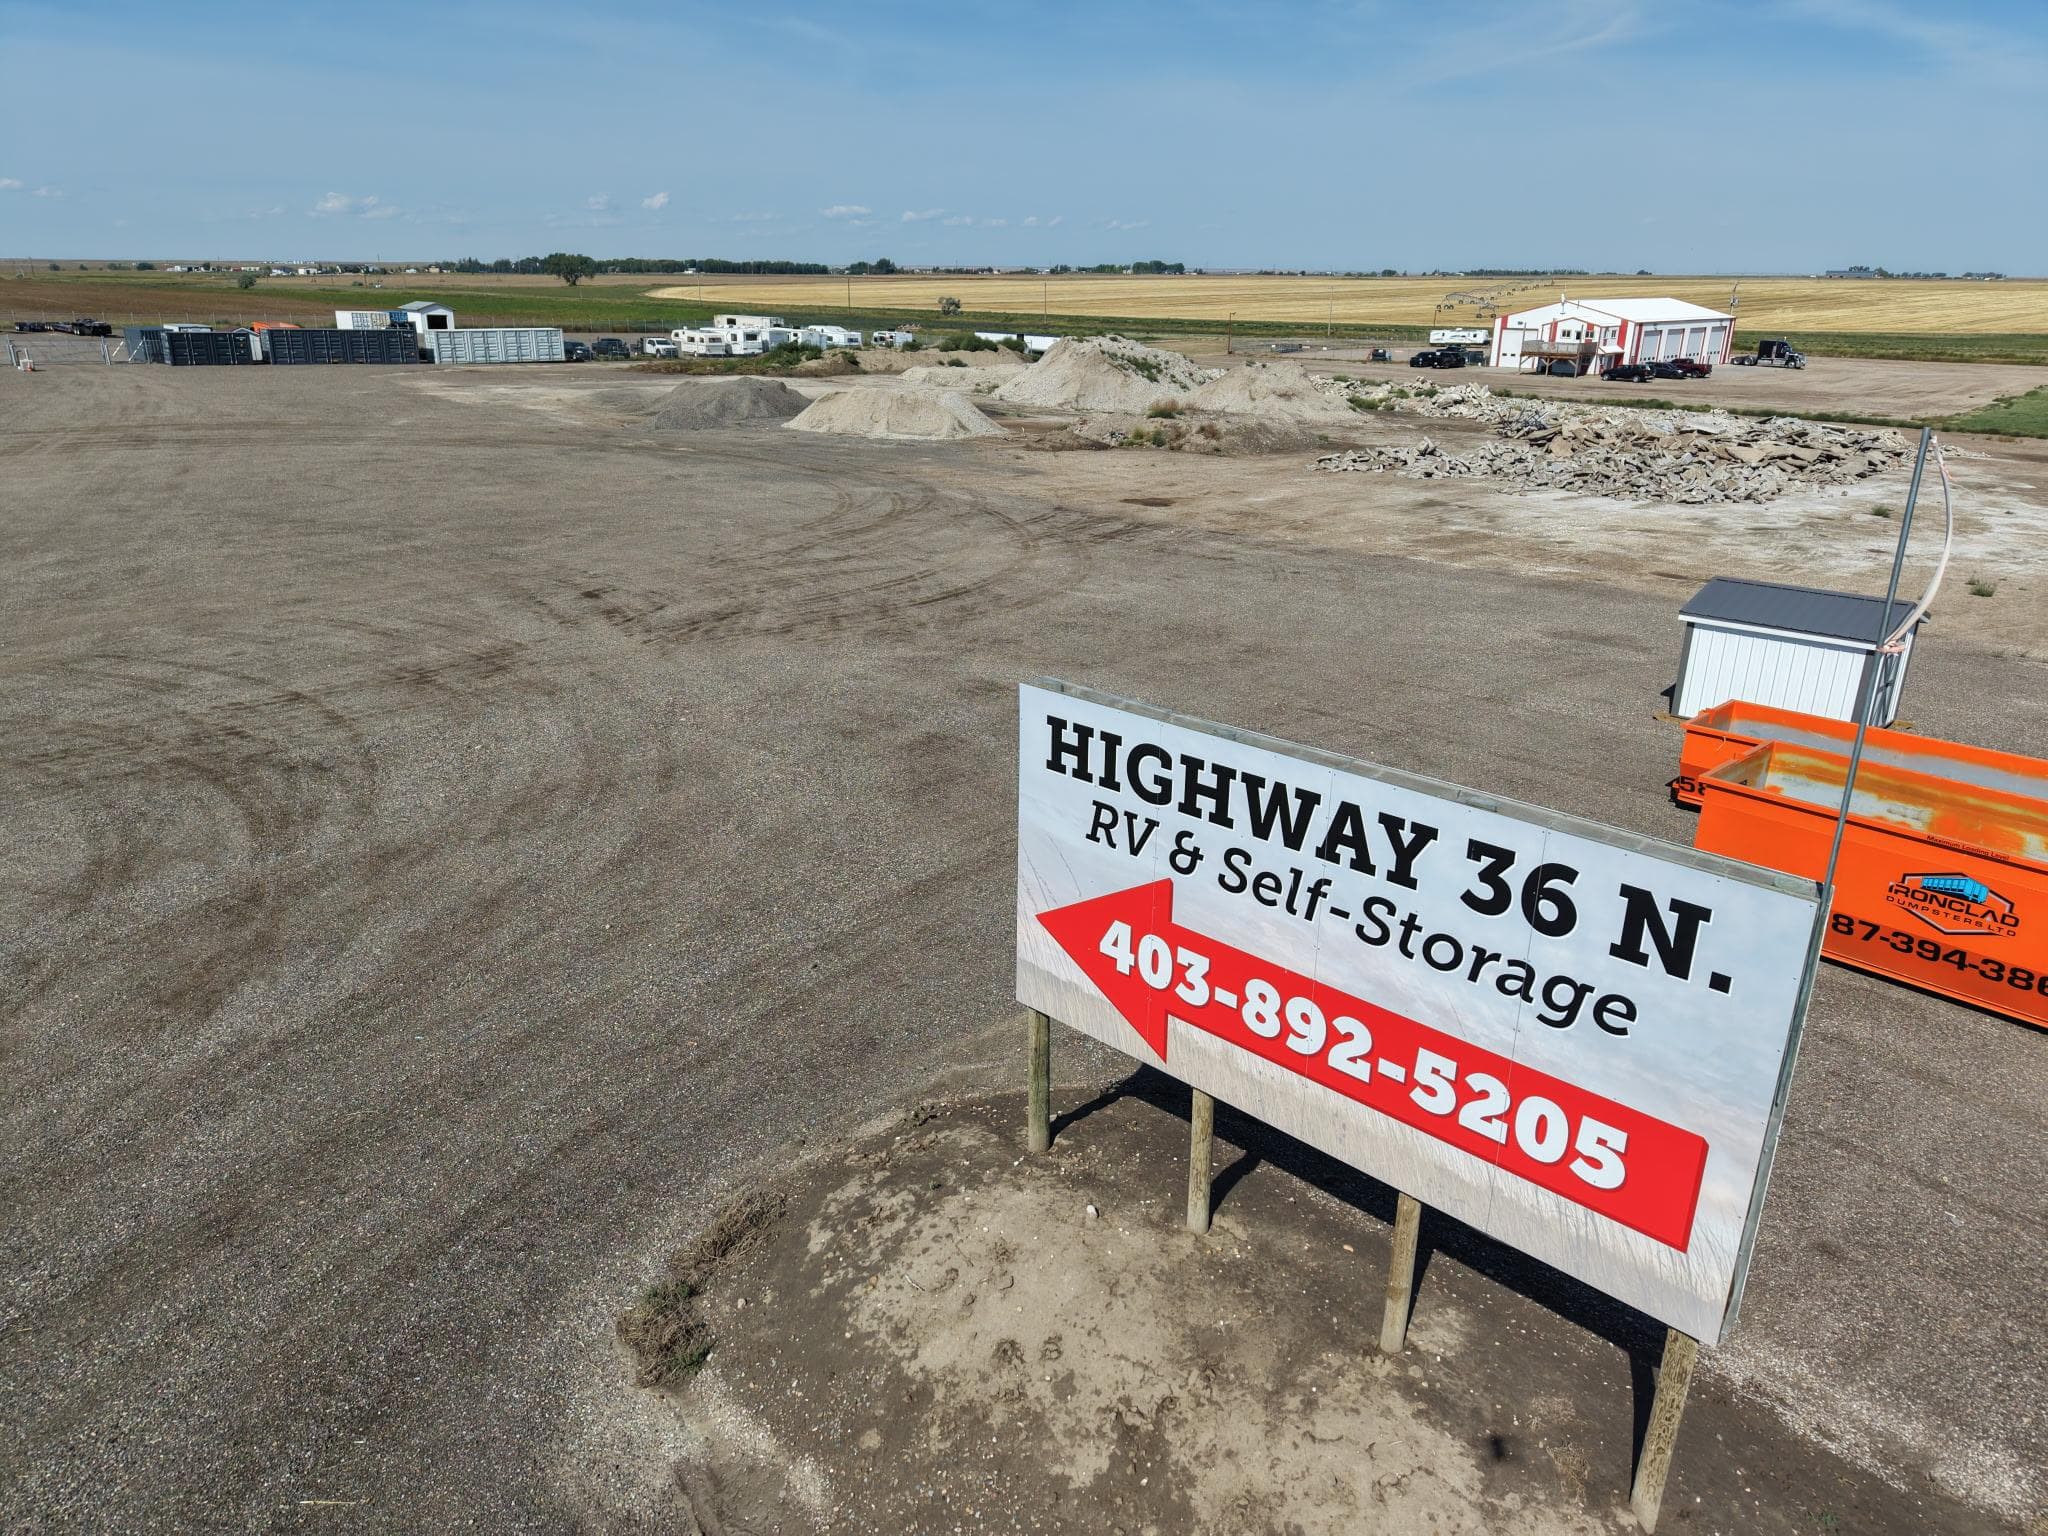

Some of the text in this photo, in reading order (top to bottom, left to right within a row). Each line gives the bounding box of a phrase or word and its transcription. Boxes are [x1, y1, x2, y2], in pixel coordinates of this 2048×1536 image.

[1046, 715, 1732, 994] HIGHWAY 36 N.
[1085, 799, 1638, 1036] RV & Self-Storage
[1886, 894, 2017, 937] DUMPSTERS LTD
[1887, 882, 2020, 928] IRONCLAD
[1926, 834, 2010, 861] Maximum Loading Level
[1098, 919, 1630, 1192] 403-892-5205
